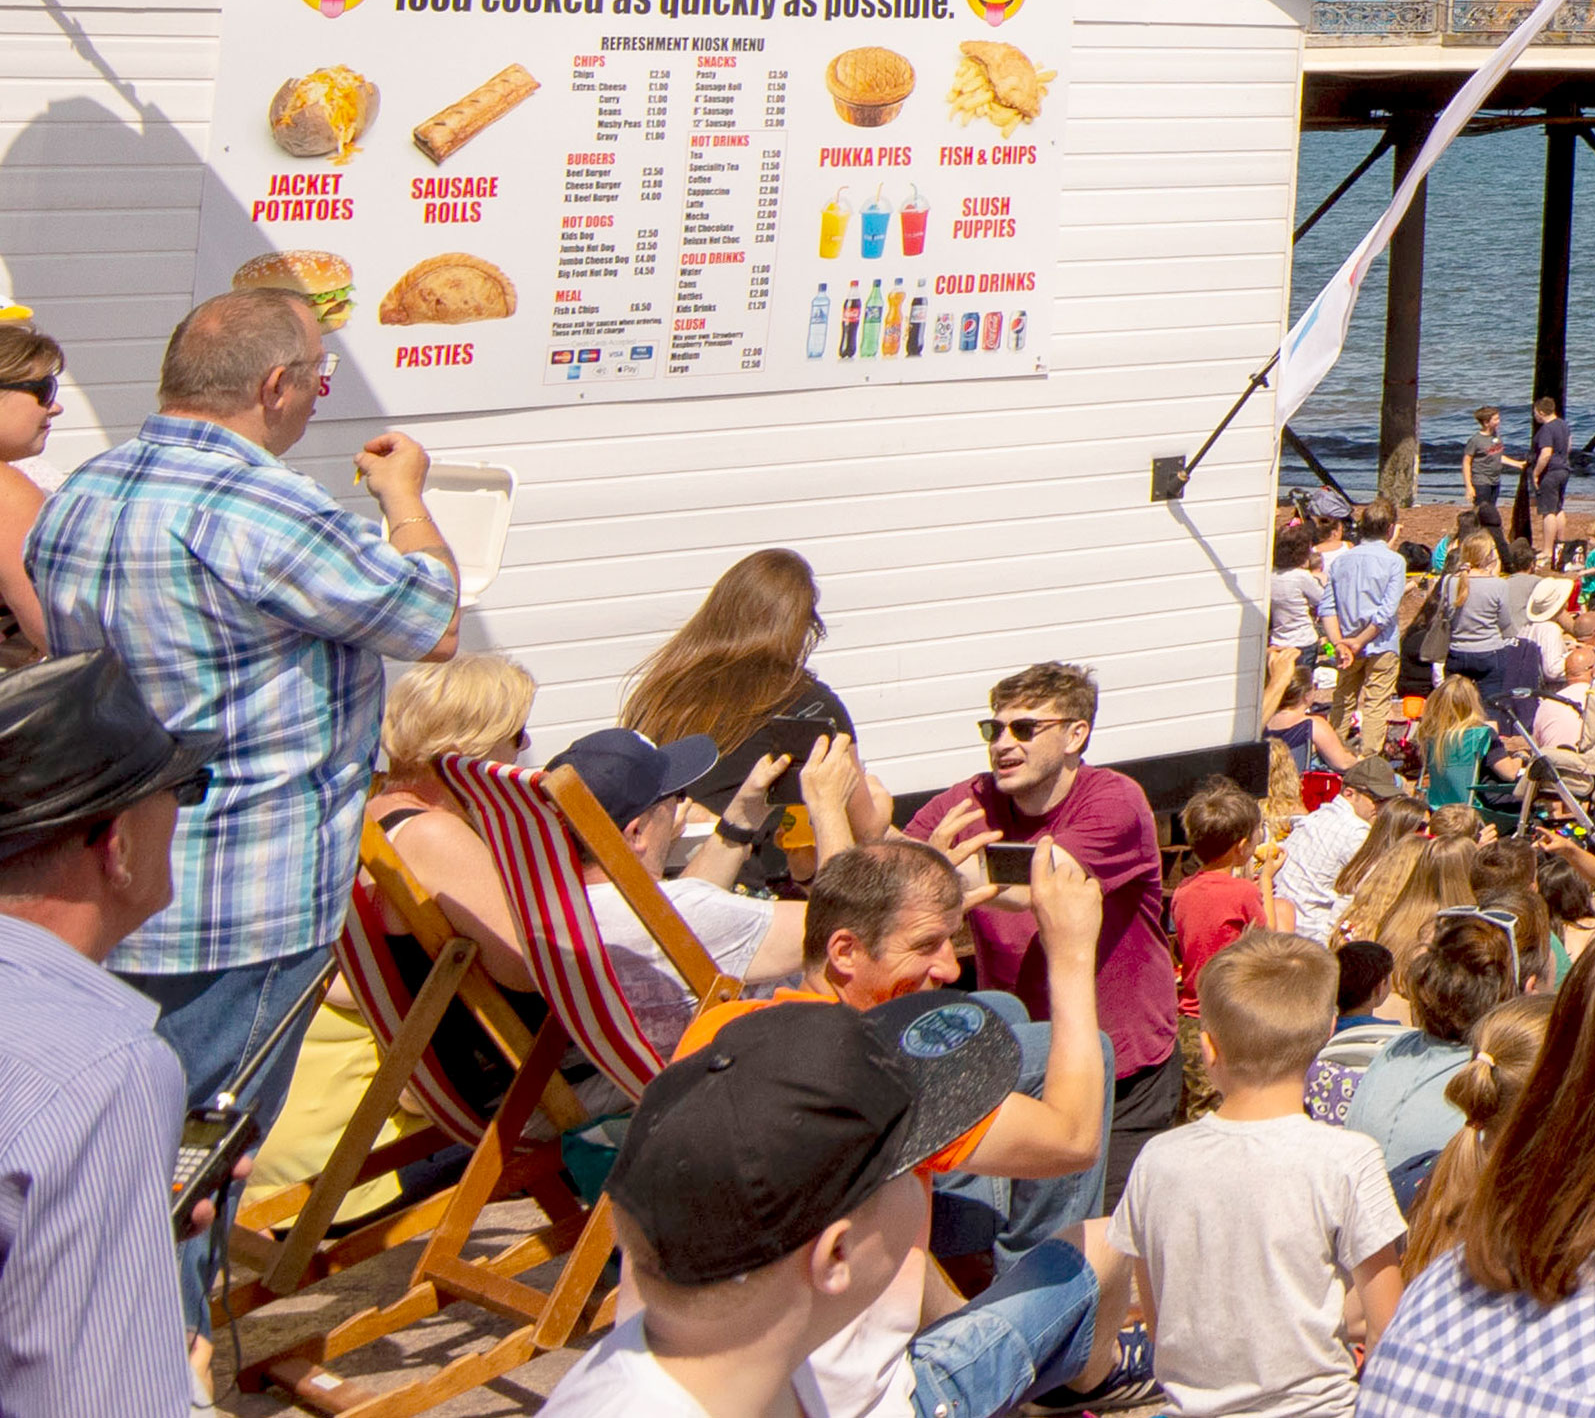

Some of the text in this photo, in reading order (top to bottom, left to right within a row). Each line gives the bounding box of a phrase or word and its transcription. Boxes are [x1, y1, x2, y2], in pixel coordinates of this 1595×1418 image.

[601, 36, 765, 52] REFRESHMENT KIOSK MENU
[574, 56, 605, 67] CHIPS
[697, 56, 736, 68] SNACKS
[696, 71, 716, 79] Pasty
[599, 83, 627, 91] Cheese
[695, 83, 726, 91] Sausage
[599, 95, 620, 104] Curry
[704, 95, 734, 103] Sausage
[703, 107, 733, 115] Sausage
[598, 120, 621, 128] Mushy
[624, 120, 641, 128] Peas
[705, 119, 736, 128] Sausage
[597, 132, 618, 141] Gravy
[691, 135, 749, 147] HOT DRINKS
[567, 153, 615, 165] BURGERS
[690, 151, 703, 159] Tea
[819, 146, 912, 167] PUKKA PIES
[939, 145, 1037, 166] FISH & CHIPS
[727, 163, 739, 171] Tea
[567, 169, 611, 177] Beef Burger
[268, 174, 343, 196] JACKET
[411, 176, 499, 199] SAUSAGE
[688, 188, 730, 196] Cappuccino
[574, 194, 592, 202] Beef
[593, 194, 618, 202] Burger
[252, 198, 354, 222] POTATOES
[962, 197, 1011, 217] SLUSH
[424, 201, 482, 224] ROLLS
[562, 215, 614, 228] HOT DOGS
[684, 224, 734, 233] Hot Chocolate
[952, 219, 1016, 239] PUPPIES
[561, 232, 577, 240] Kids
[580, 232, 594, 240] Dog
[560, 245, 584, 253] Jumbo
[601, 244, 615, 252] Dog
[559, 258, 583, 266] Jumbo
[585, 256, 613, 264] Cheese
[615, 255, 629, 264] Dog
[681, 252, 745, 265] COLD DRINKS
[558, 270, 570, 279] Big
[572, 269, 587, 277] Foot
[603, 268, 618, 277] Dog
[935, 272, 1036, 295] COLD DRINKS
[556, 290, 582, 302] MEAL
[678, 293, 702, 301] Bottles
[554, 306, 599, 315] Fish Chips
[676, 304, 716, 313] Kids Drinks
[674, 319, 705, 331] SLUSH
[396, 342, 474, 368] PASTIES
[670, 353, 700, 361] Medium
[669, 365, 689, 373] Large
